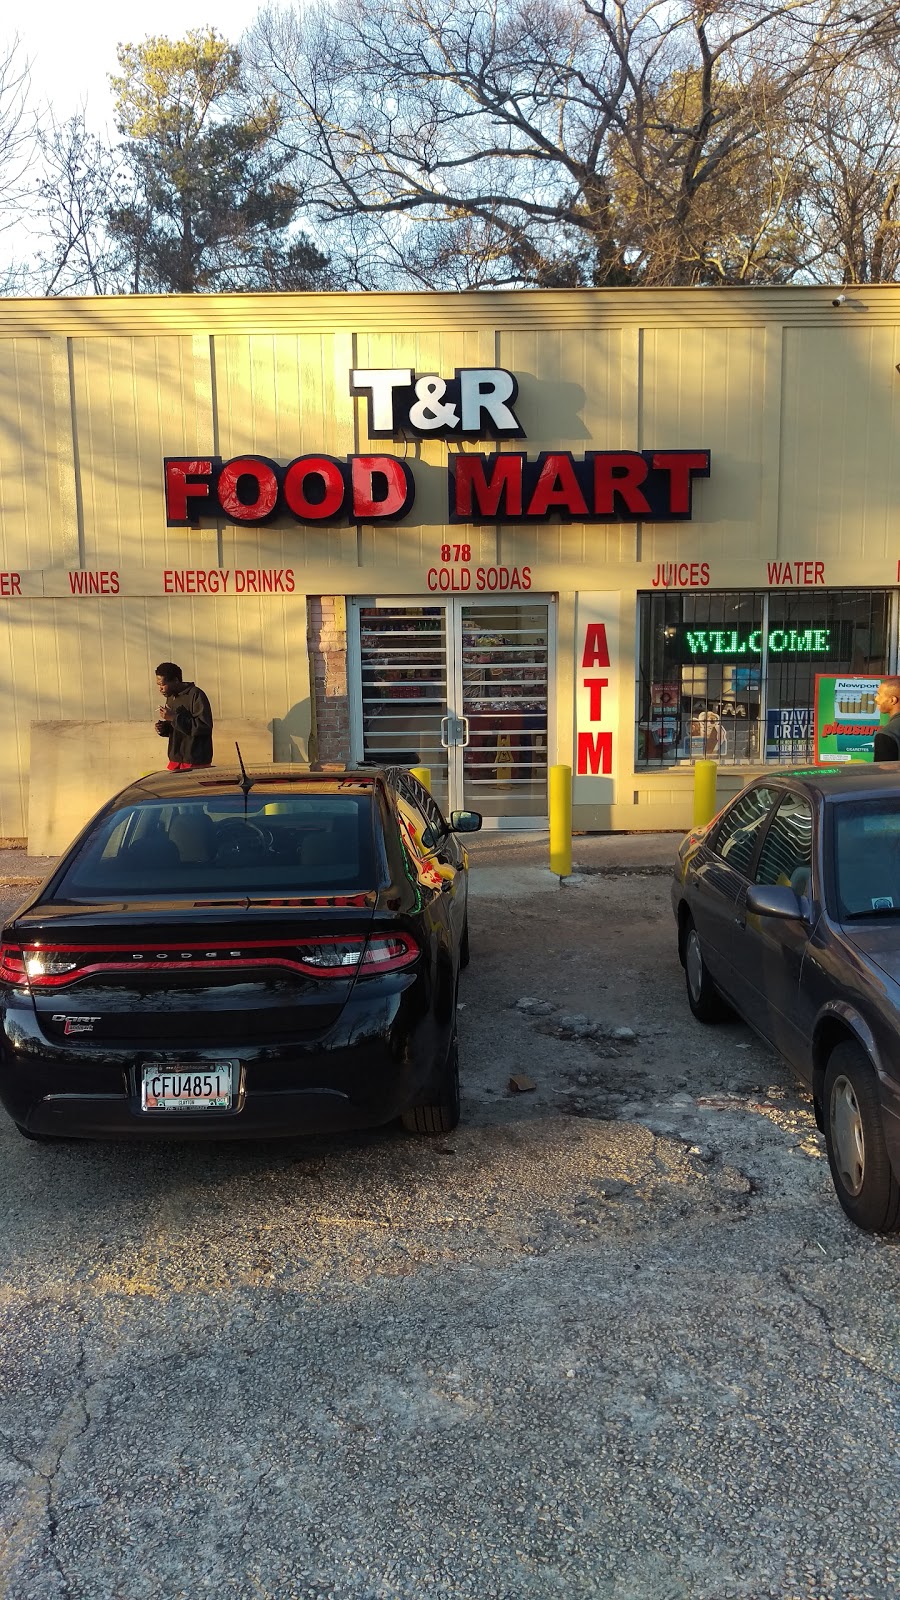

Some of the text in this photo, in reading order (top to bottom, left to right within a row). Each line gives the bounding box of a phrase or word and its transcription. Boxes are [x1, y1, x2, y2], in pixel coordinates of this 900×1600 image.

[352, 368, 519, 431] T&R
[166, 453, 708, 520] FOOD MART
[440, 543, 472, 563] 878
[0, 572, 22, 596] ER
[68, 570, 120, 594] WINES
[163, 569, 296, 593] ENERGY DRINKS
[427, 566, 532, 591] COLD SODAS
[651, 562, 710, 587] JUICES
[767, 561, 825, 585] WATER
[686, 629, 831, 654] WELCOME
[577, 623, 613, 776] ATM
[821, 722, 883, 738] pleasur
[133, 951, 241, 960] DODGE
[151, 1075, 221, 1098] CFU4851
